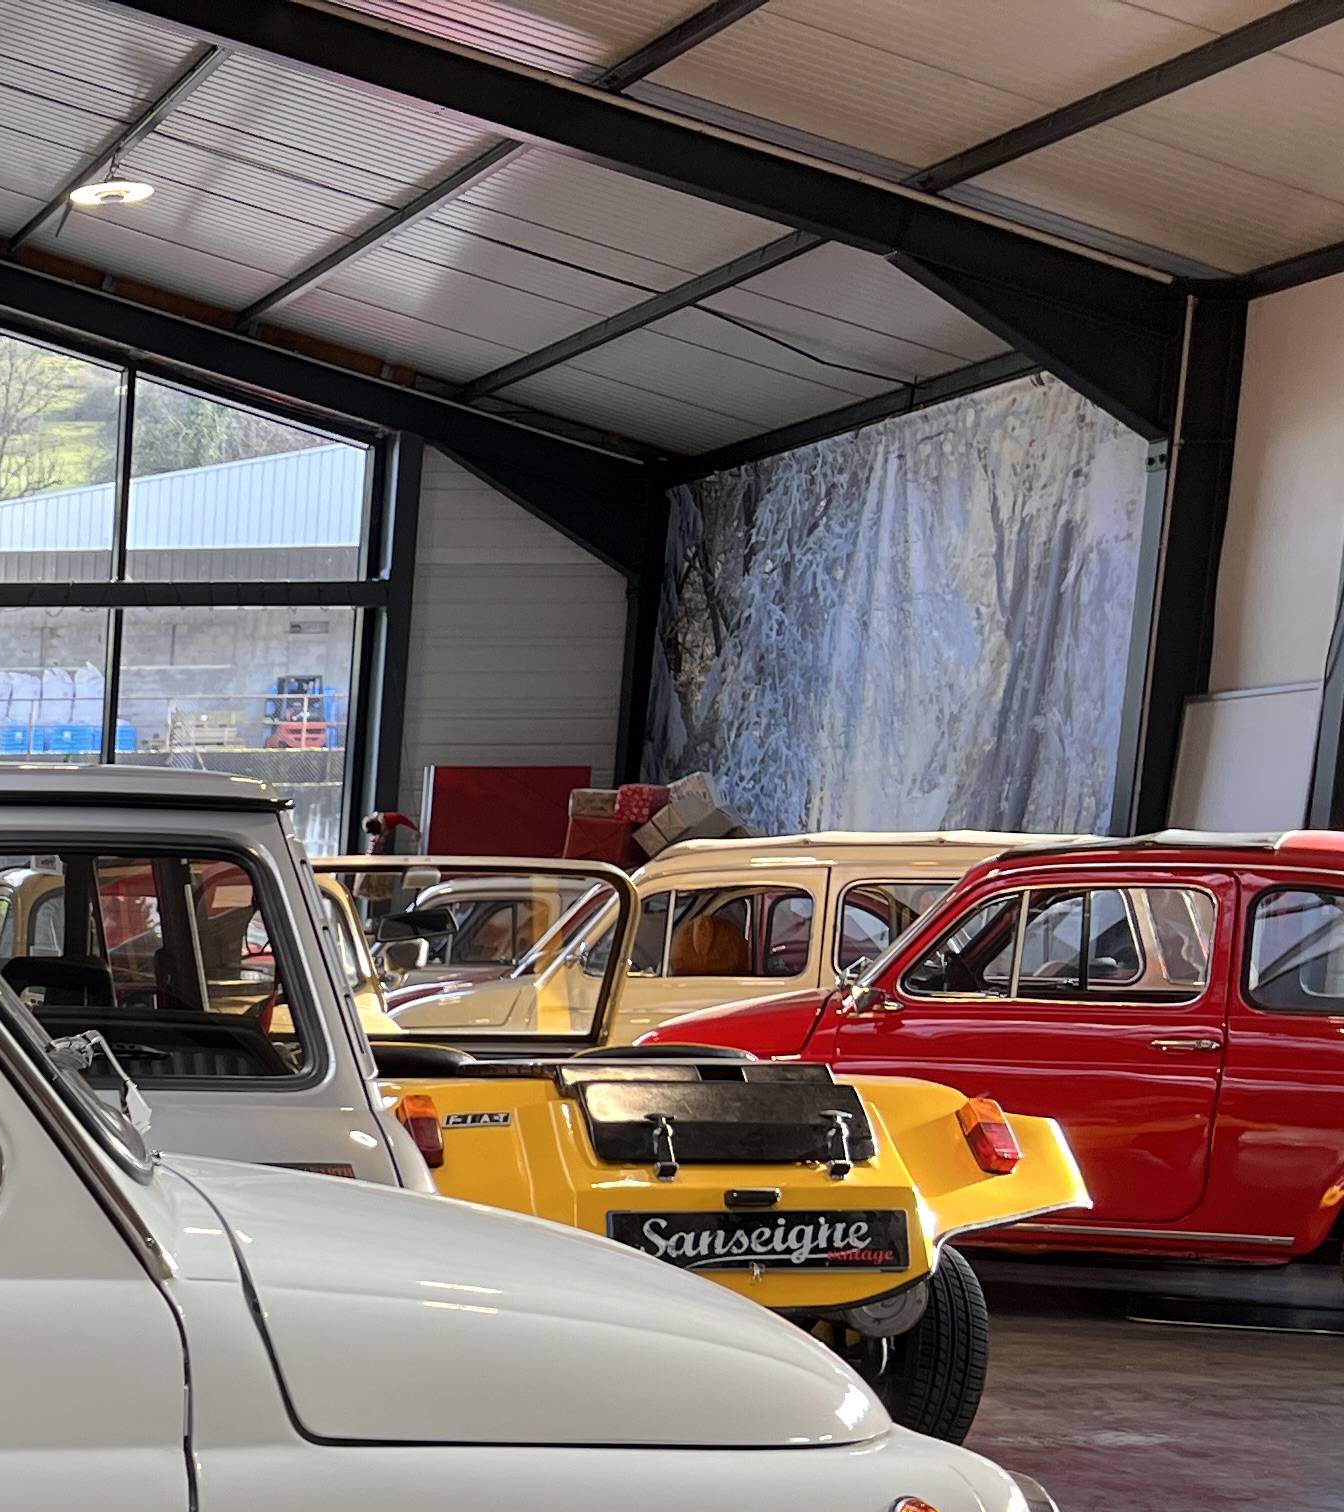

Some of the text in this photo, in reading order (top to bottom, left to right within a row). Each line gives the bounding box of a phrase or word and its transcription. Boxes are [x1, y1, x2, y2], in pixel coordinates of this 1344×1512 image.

[448, 1113, 507, 1125] FIAT
[640, 1217, 872, 1263] Sanseigne
[827, 1248, 894, 1263] vintage
